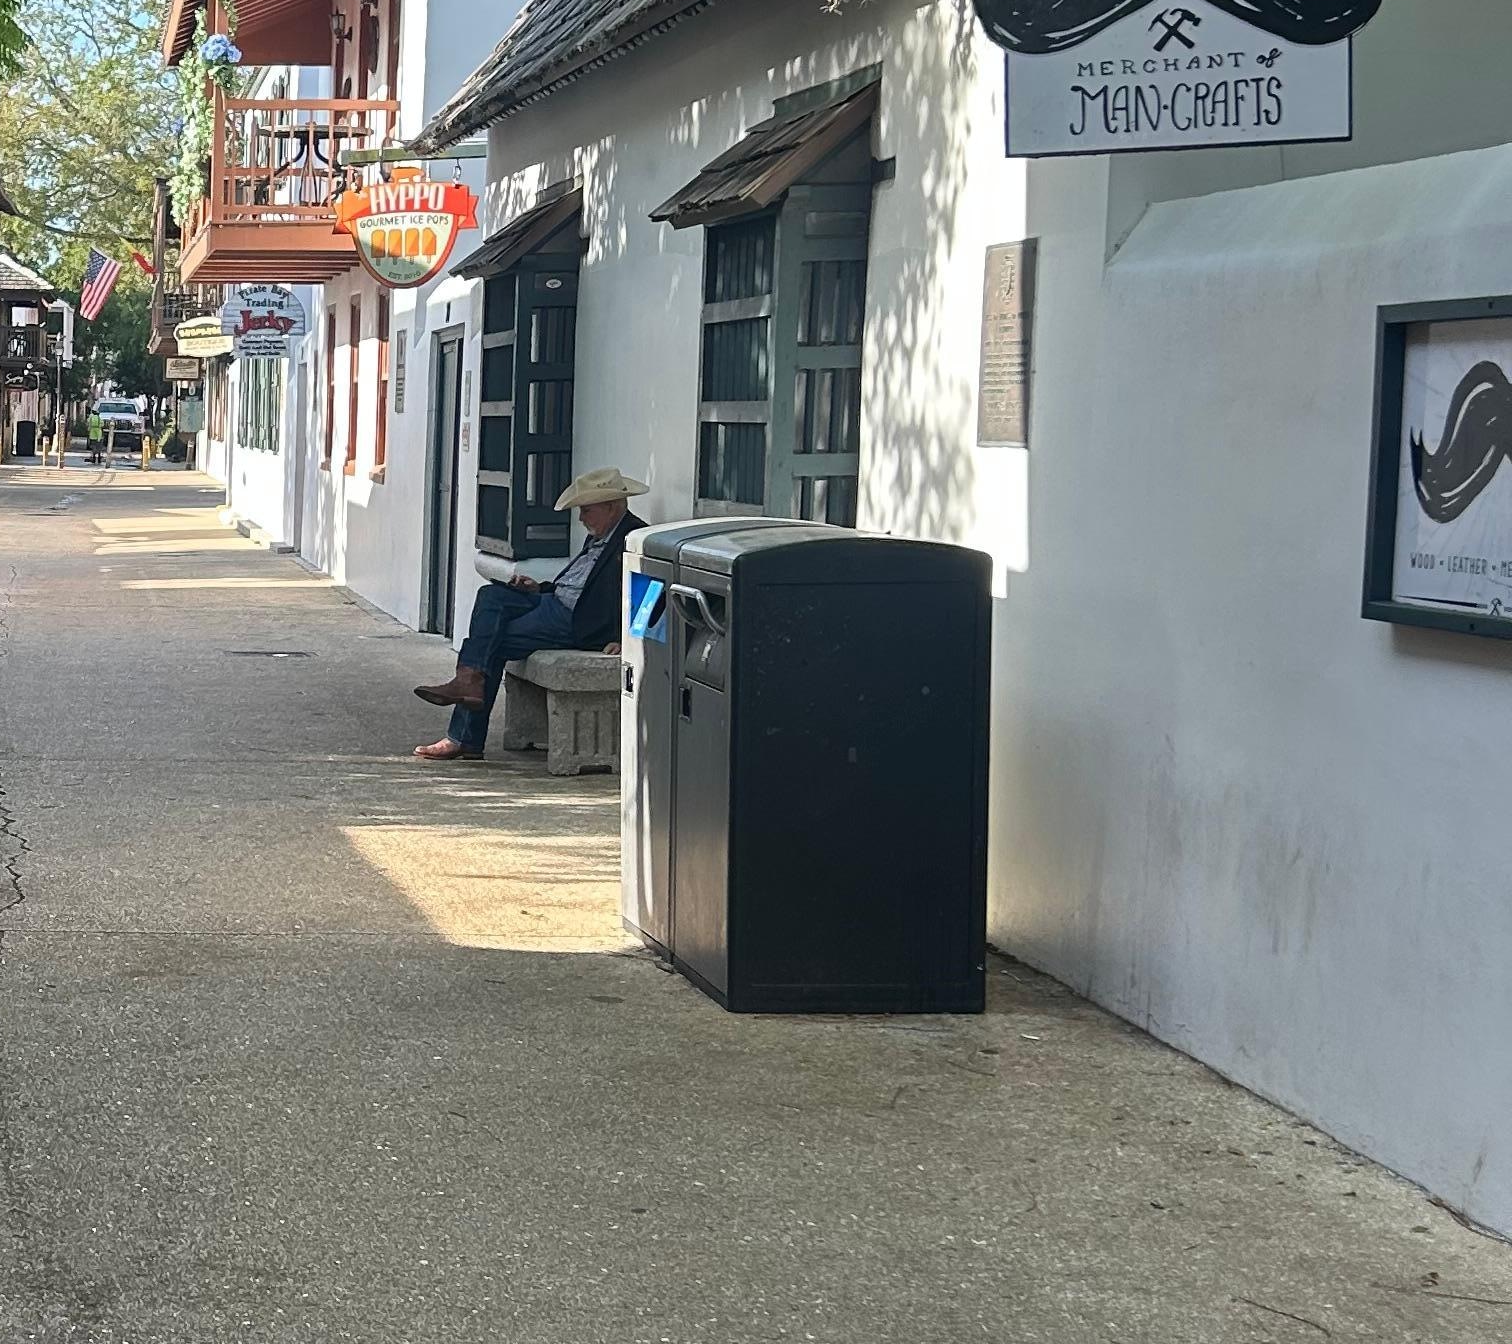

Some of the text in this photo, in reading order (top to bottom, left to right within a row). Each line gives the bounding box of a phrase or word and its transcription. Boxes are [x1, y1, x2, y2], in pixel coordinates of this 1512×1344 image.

[1077, 48, 1282, 77] MERCHANT of
[370, 184, 445, 213] HYPPO
[360, 215, 449, 229] GOURMET ICE POPS
[238, 284, 289, 299] Pirate Bay
[245, 298, 284, 309] Trading
[234, 310, 297, 336] Jerky
[1410, 552, 1436, 569] WOOD
[1448, 555, 1487, 575] LEATHER
